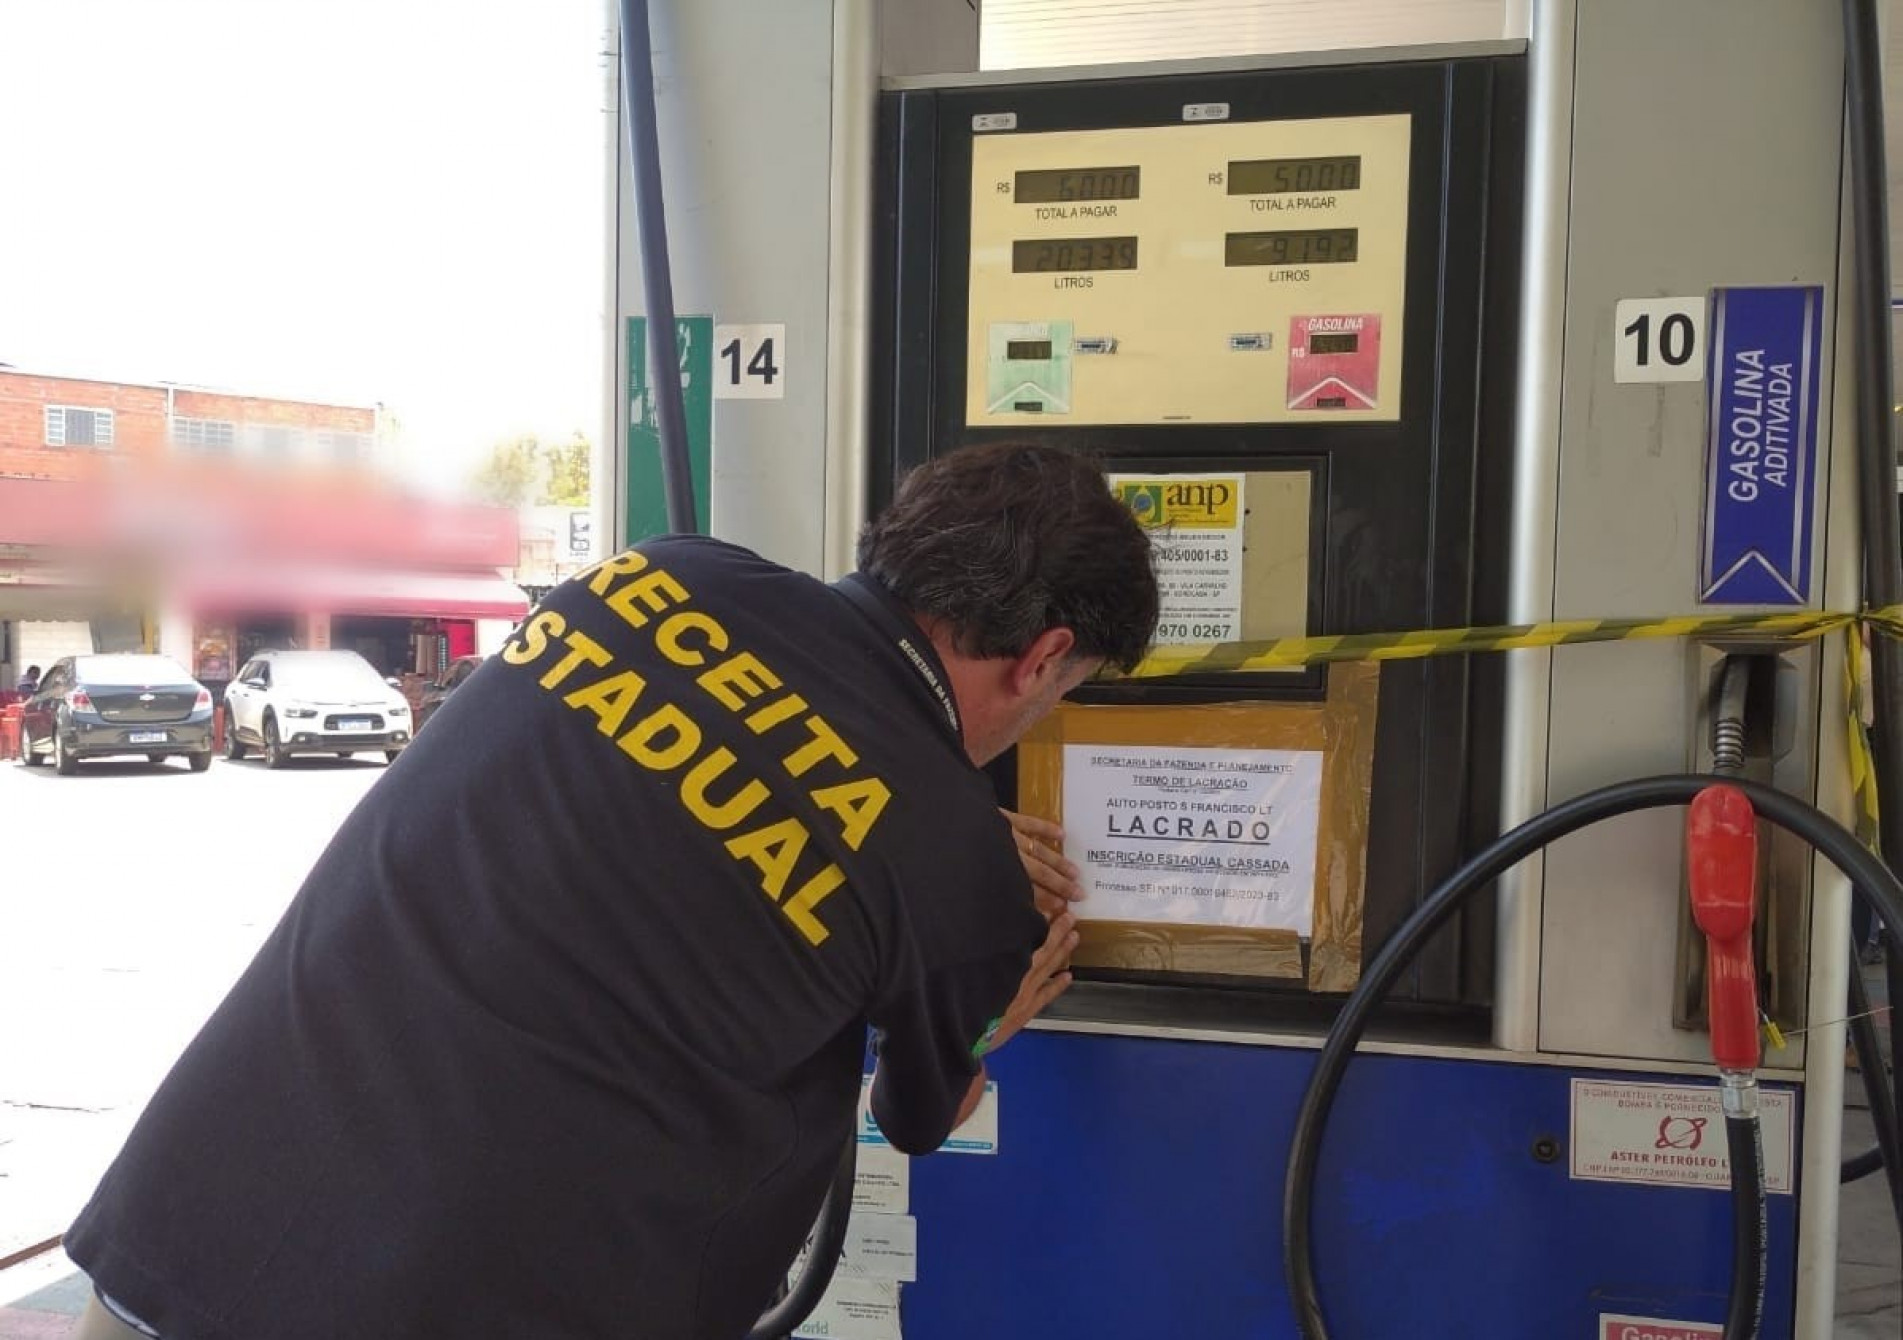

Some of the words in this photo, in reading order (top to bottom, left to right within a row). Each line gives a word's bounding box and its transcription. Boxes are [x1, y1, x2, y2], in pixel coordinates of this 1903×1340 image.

[1035, 207, 1068, 220] TOTAL
[1070, 207, 1078, 217] A
[1079, 205, 1117, 217] PAGAR
[1250, 199, 1284, 211] TOTAL
[1285, 199, 1295, 211] A
[1297, 197, 1336, 209] PAGAR
[1053, 276, 1094, 289] LITROS
[1269, 270, 1310, 282] LITROS
[1308, 317, 1363, 331] GASOLINA
[1624, 313, 1696, 366] 10
[720, 337, 779, 385] 14
[1728, 349, 1766, 502] GASOLINA
[1764, 362, 1793, 487] ADITIVADA
[1167, 483, 1229, 515] anp
[1157, 624, 1188, 638] 970
[1193, 624, 1232, 638] 0267
[573, 550, 893, 852] RECEITA
[1090, 756, 1148, 768] SECRETARIA
[1150, 759, 1162, 768] DA
[1163, 759, 1206, 770] FAZENDA
[1217, 762, 1293, 774] PLANEJAMENTO
[500, 606, 847, 947] STADUAL
[1132, 774, 1168, 786] TERMO
[1171, 776, 1186, 786] DE
[1188, 777, 1248, 789] LACRAÇÃO
[1106, 798, 1137, 809] AUTO
[1139, 800, 1178, 811] POSTO
[1180, 801, 1188, 811] S
[1190, 803, 1256, 814] FRANCISCO
[1259, 805, 1273, 815] LT
[1107, 814, 1271, 841] LACRADO
[1087, 850, 1154, 864] INSCRIÇÃO
[1157, 853, 1224, 867] ESTADUAL
[1227, 857, 1289, 871] CASSADA
[1611, 1150, 1650, 1164] ASTER
